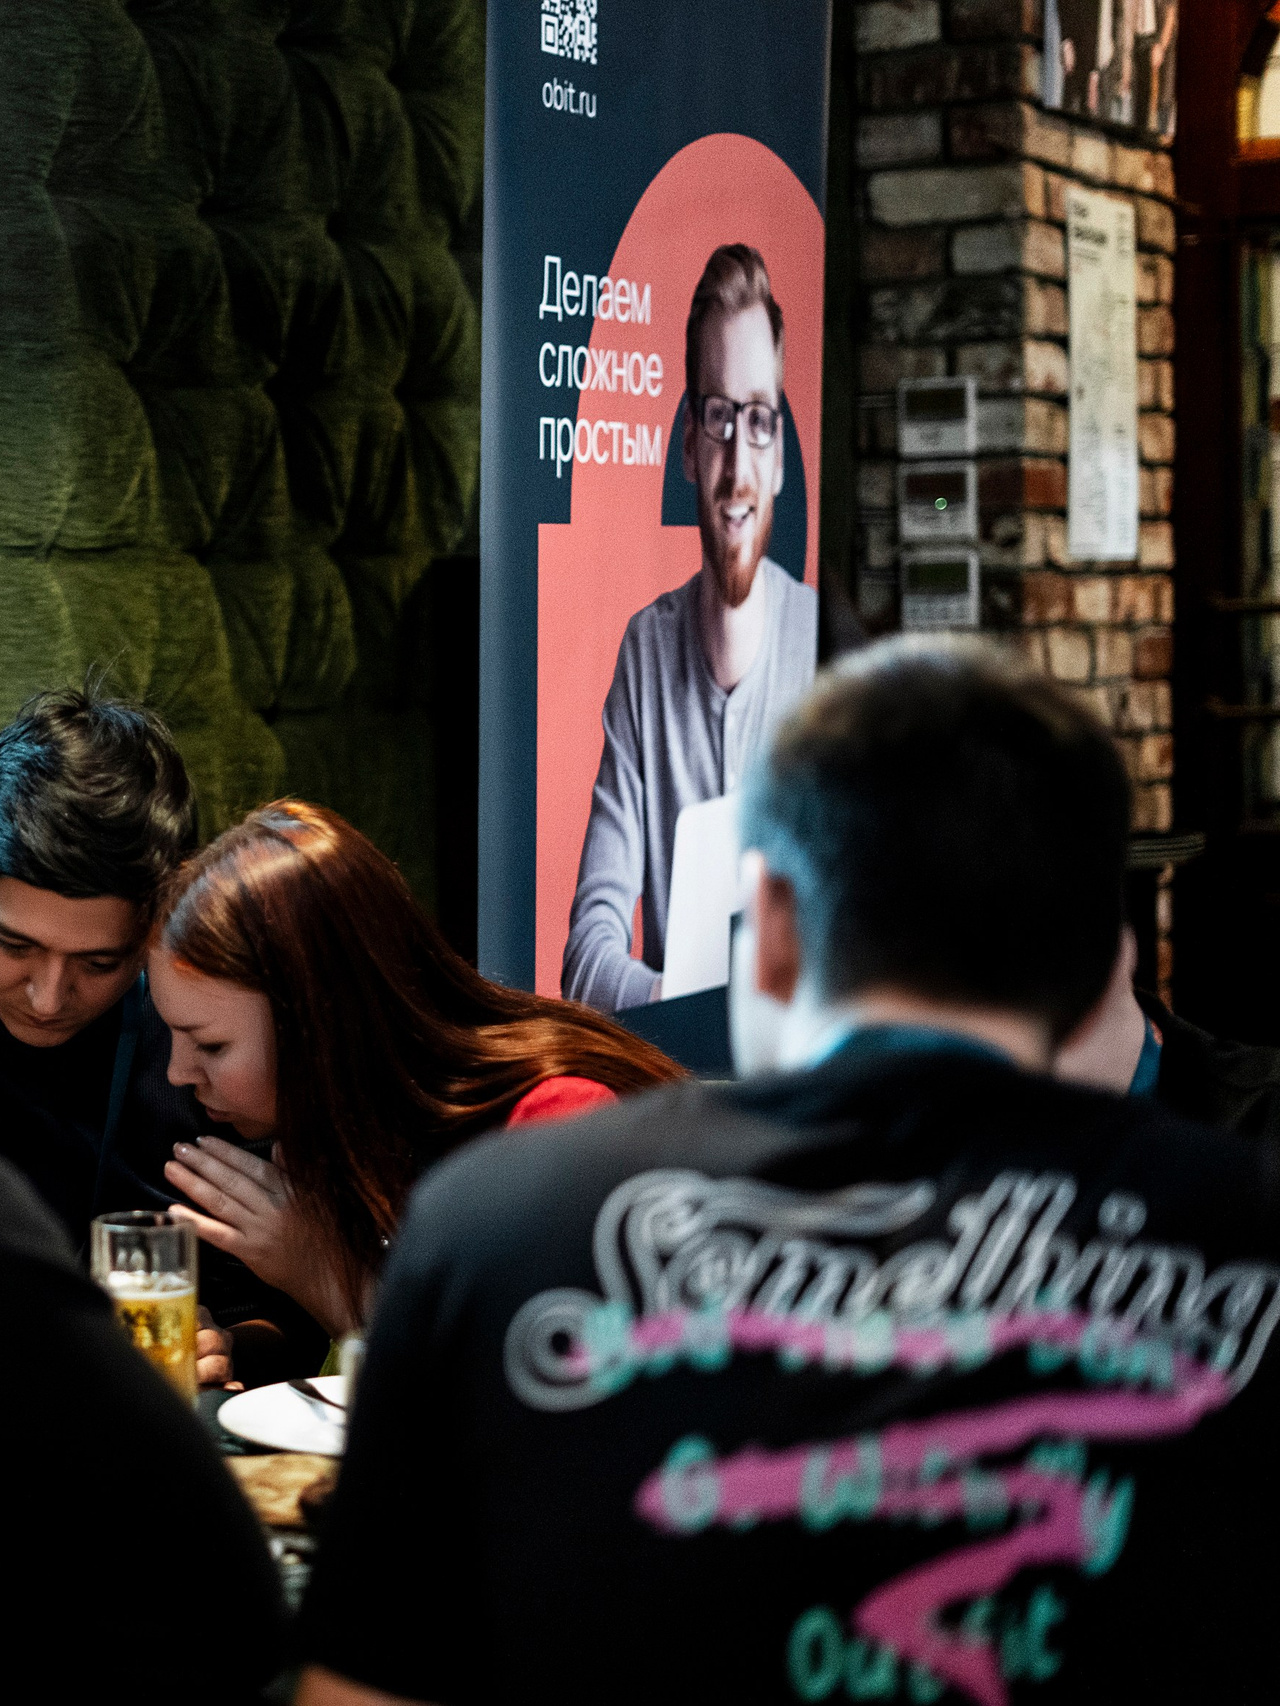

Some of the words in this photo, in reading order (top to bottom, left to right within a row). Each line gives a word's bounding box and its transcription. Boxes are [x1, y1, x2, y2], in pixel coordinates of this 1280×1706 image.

[542, 77, 597, 118] obit.ru
[539, 255, 651, 325] Делаем
[539, 342, 663, 398] сложное
[539, 416, 662, 477] простым
